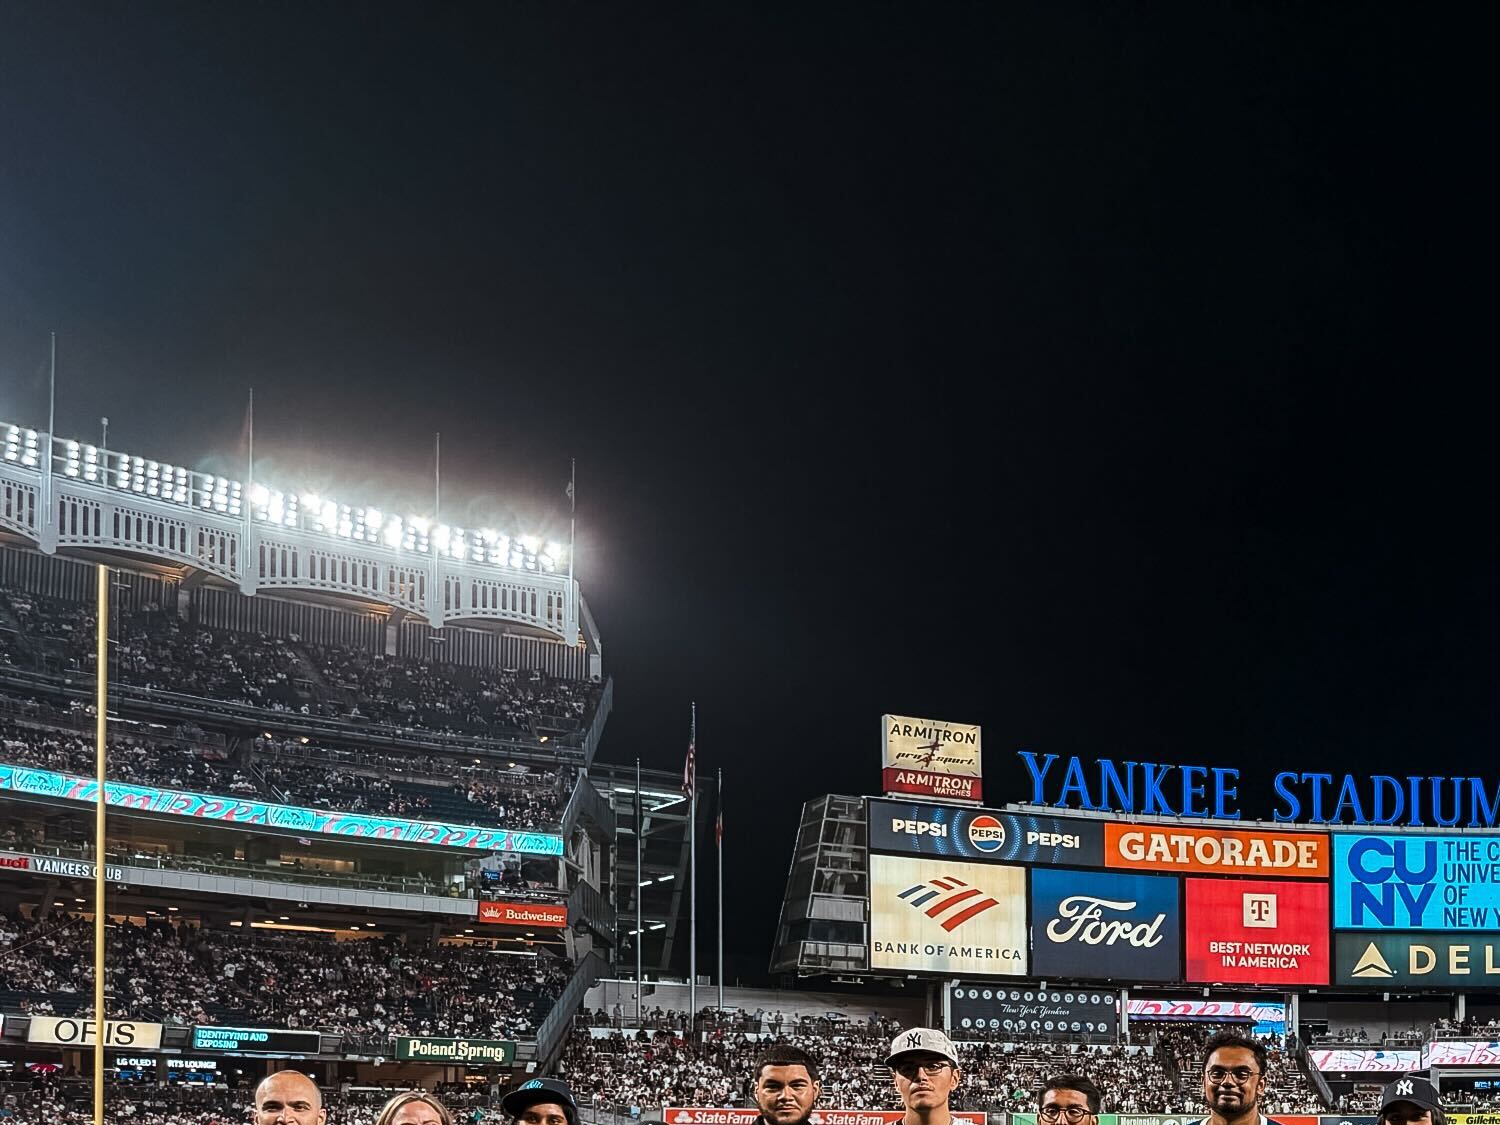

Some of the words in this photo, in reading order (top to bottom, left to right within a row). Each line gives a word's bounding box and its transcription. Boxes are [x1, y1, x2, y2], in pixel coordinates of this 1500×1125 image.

[890, 723, 976, 745] ARMITRON
[895, 771, 973, 790] ARMITRON
[1017, 750, 1242, 819] YANKEE
[933, 786, 971, 797] WATCHES
[892, 818, 947, 837] PEPSI
[970, 828, 1004, 840] PEPSI
[1027, 831, 1080, 849] PEPSI
[1118, 832, 1318, 869] GATORADE
[1444, 842, 1480, 861] THE
[35, 858, 90, 876] YANKEES
[92, 869, 122, 880] CUB
[1348, 836, 1438, 886] CU
[1351, 882, 1436, 927] NY
[1444, 885, 1468, 906] OF
[506, 911, 565, 923] Budweiser
[1047, 896, 1167, 948] Ford
[1443, 908, 1489, 928] NEW
[874, 941, 919, 954] BANK
[924, 945, 944, 956] OF
[948, 946, 1022, 961] AMERICA
[1209, 941, 1241, 954] BEST
[1244, 942, 1311, 957] NETWORK
[1222, 956, 1237, 967] IN
[1239, 956, 1299, 969] AMERICA
[1001, 1004, 1019, 1013] New
[1019, 1005, 1038, 1019] York
[1039, 1005, 1070, 1019] Yankees
[197, 1039, 238, 1049] EXPOSING
[198, 1030, 249, 1041] IDENTIFYING
[250, 1032, 268, 1042] AND
[906, 1032, 922, 1048] NY
[409, 1040, 455, 1057] Poland
[457, 1041, 504, 1062] Spring
[116, 1058, 128, 1066] LG
[129, 1058, 151, 1067] OLED
[184, 1060, 217, 1069] LOUNGE
[1396, 1079, 1414, 1096] NY
[1466, 1116, 1500, 1125] Gillette
